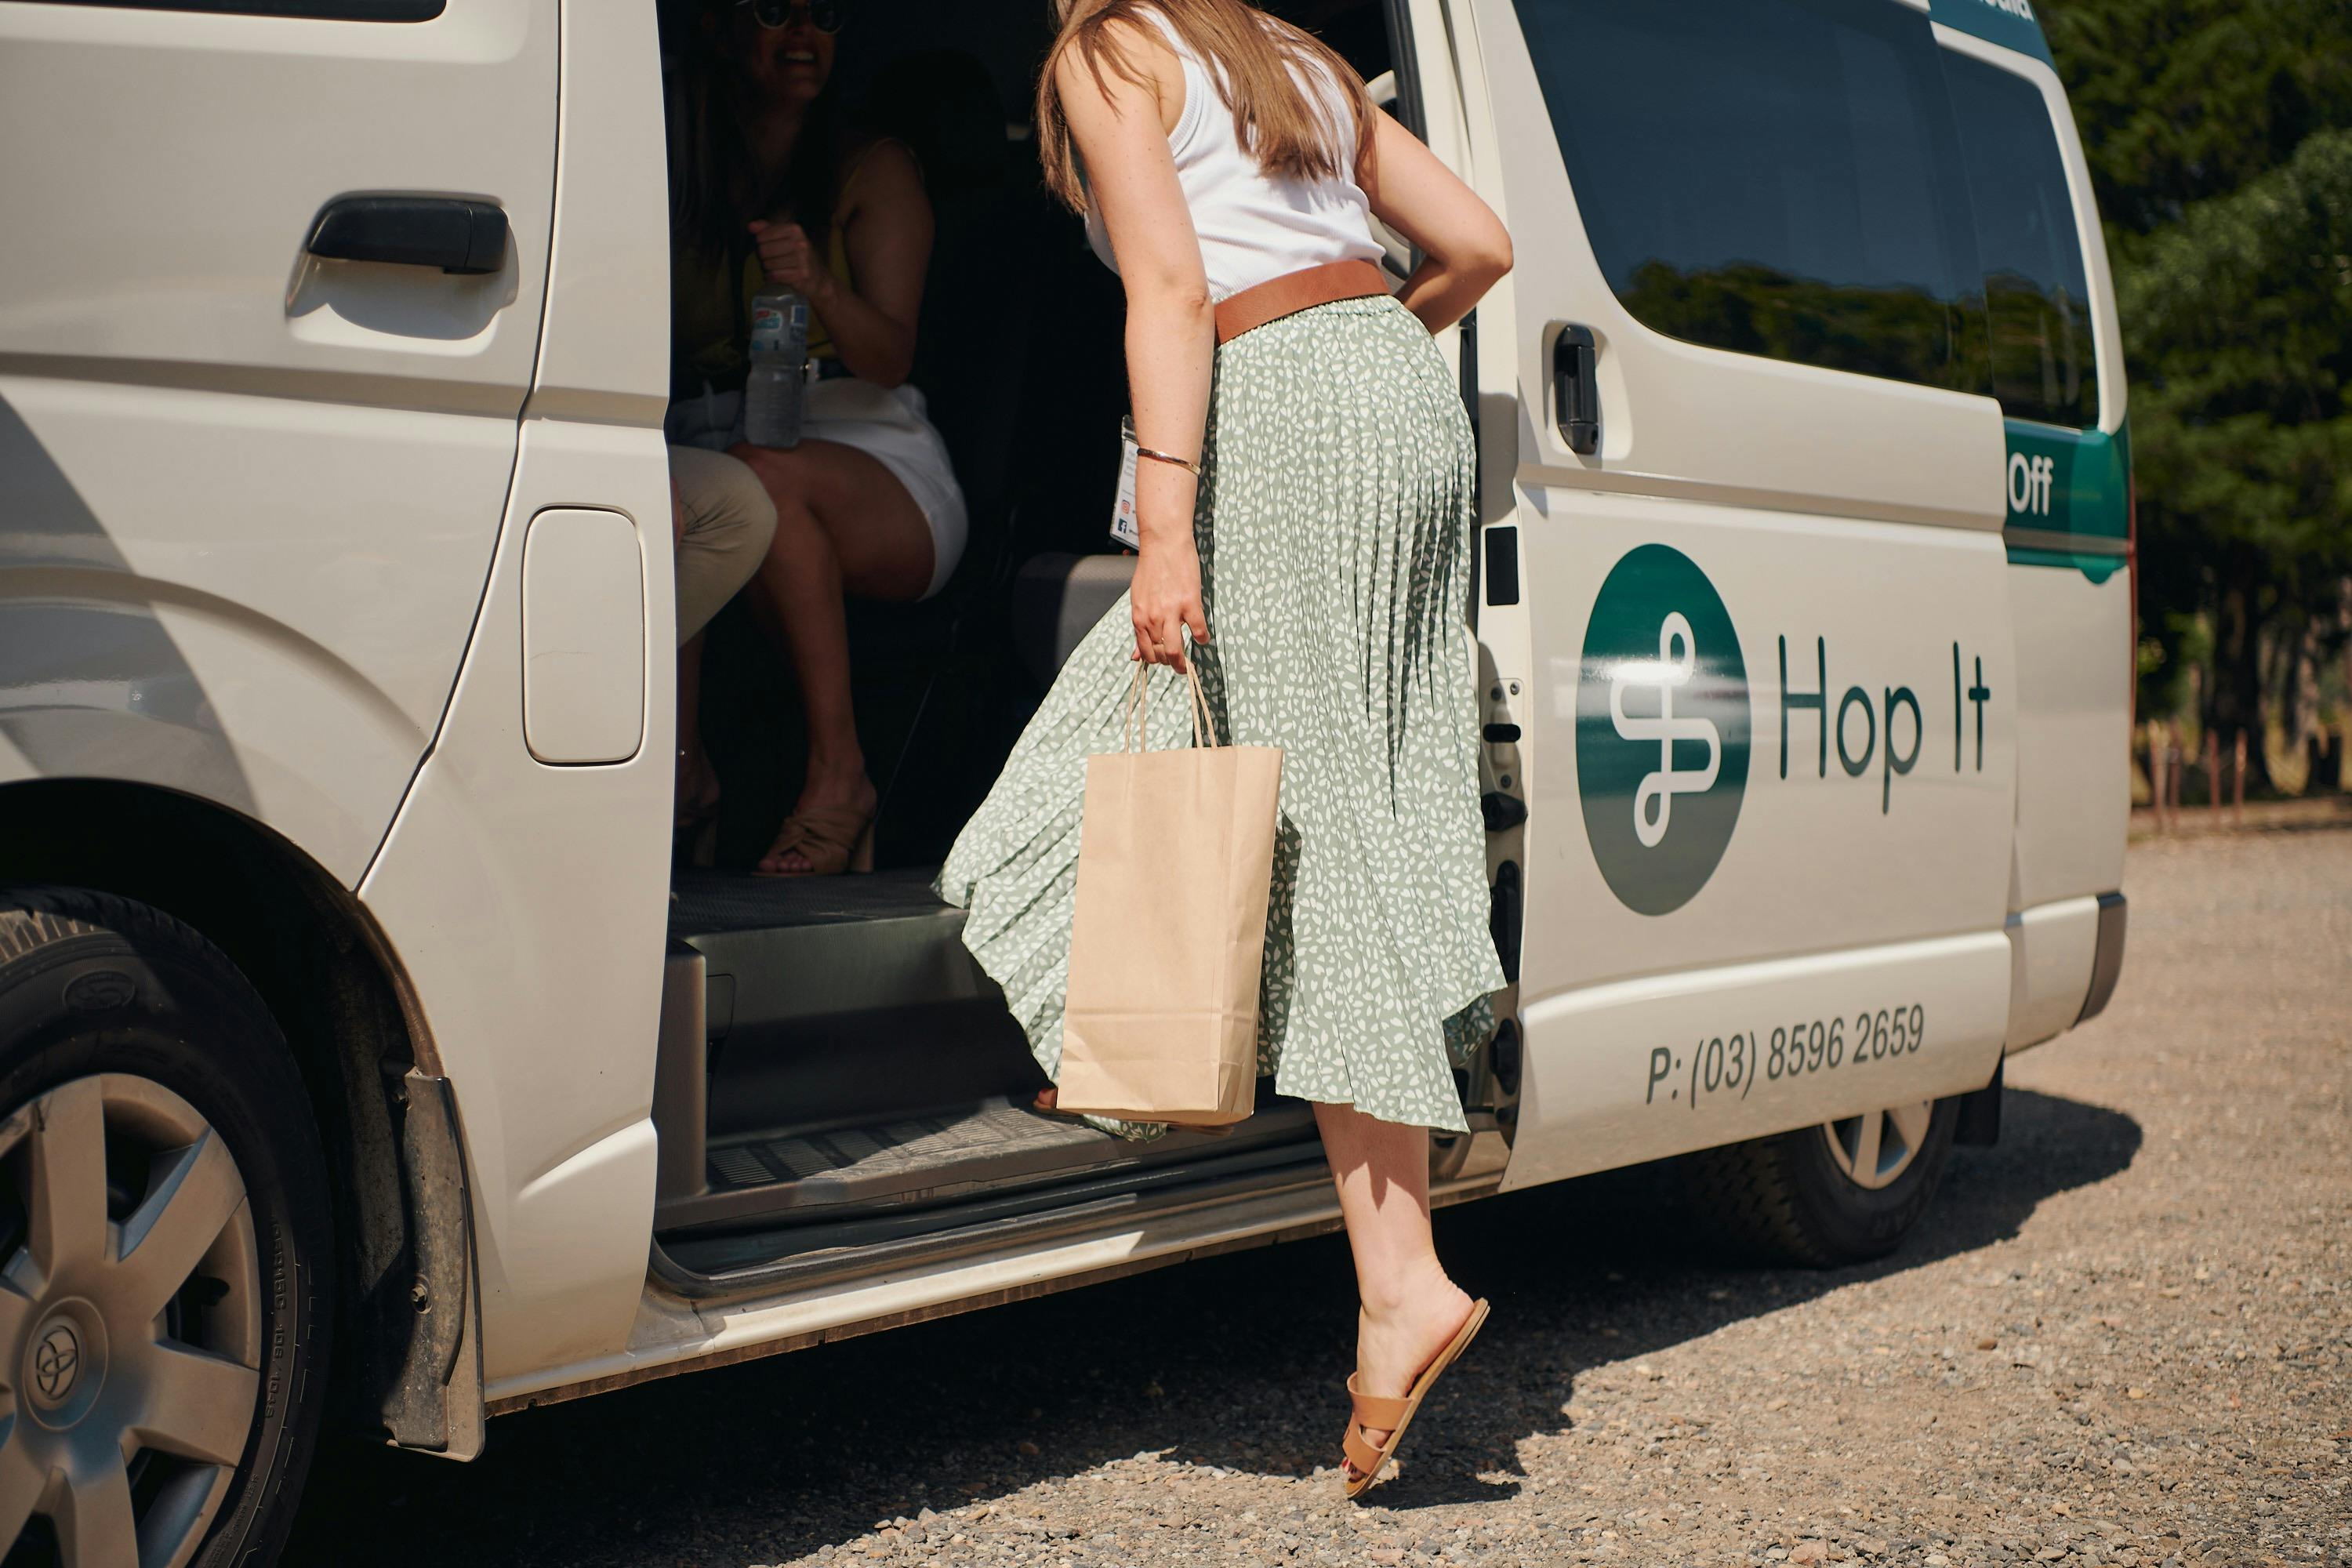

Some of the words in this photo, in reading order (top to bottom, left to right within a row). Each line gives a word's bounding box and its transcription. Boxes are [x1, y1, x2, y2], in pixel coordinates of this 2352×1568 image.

[2008, 452, 2054, 517] Off
[1779, 634, 1922, 815] Hop
[1953, 641, 1991, 773] It
[1646, 1047, 1681, 1105] P:
[1690, 1030, 1756, 1110] (03)
[1767, 1017, 1844, 1081] 8596
[1853, 1004, 1924, 1064] 2659
